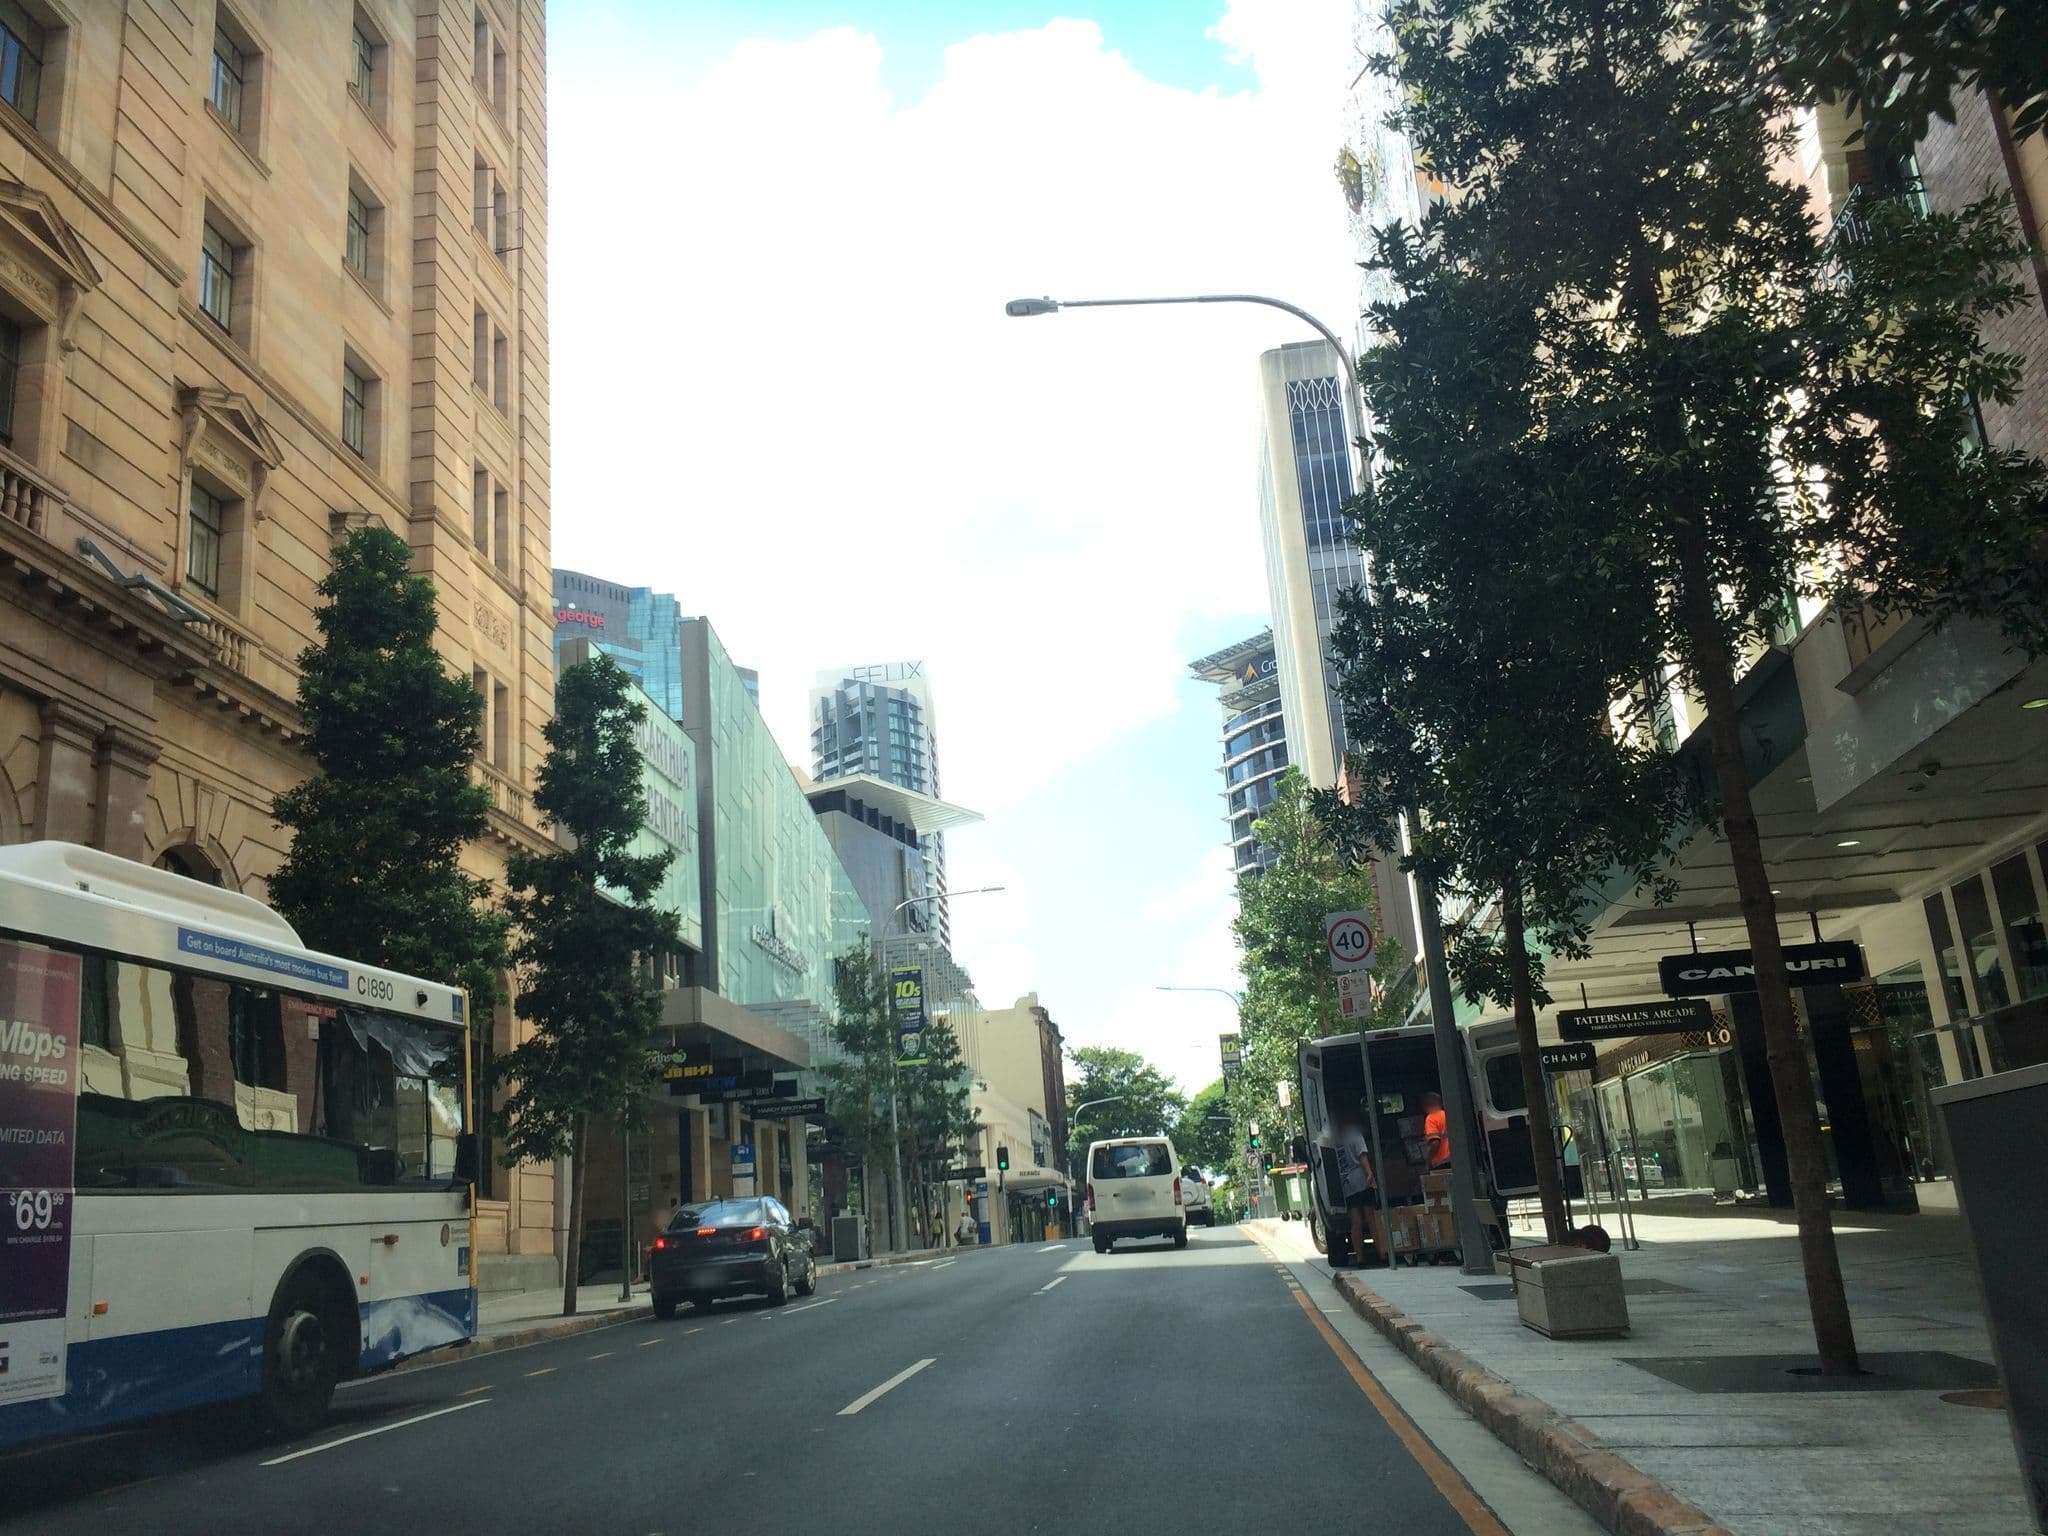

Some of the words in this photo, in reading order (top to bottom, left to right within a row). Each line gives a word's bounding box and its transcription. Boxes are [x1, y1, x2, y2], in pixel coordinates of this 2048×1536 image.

[557, 609, 606, 628] george
[853, 660, 922, 684] FELIX
[647, 783, 692, 854] CENTRAL
[186, 935, 202, 949] Get
[203, 943, 213, 951] on
[215, 941, 237, 957] board
[1335, 930, 1364, 950] 40
[1678, 957, 1846, 981] CANURI
[357, 975, 393, 1001] C1890
[895, 980, 921, 998] 10s
[1573, 1011, 1649, 1026] TATTERSALL'S
[1653, 1007, 1697, 1020] ARCADE
[1617, 1050, 1649, 1075] LONGCHAMP
[24, 1066, 67, 1085] SPEED
[663, 1067, 683, 1079] JB
[36, 1130, 65, 1145] DATA
